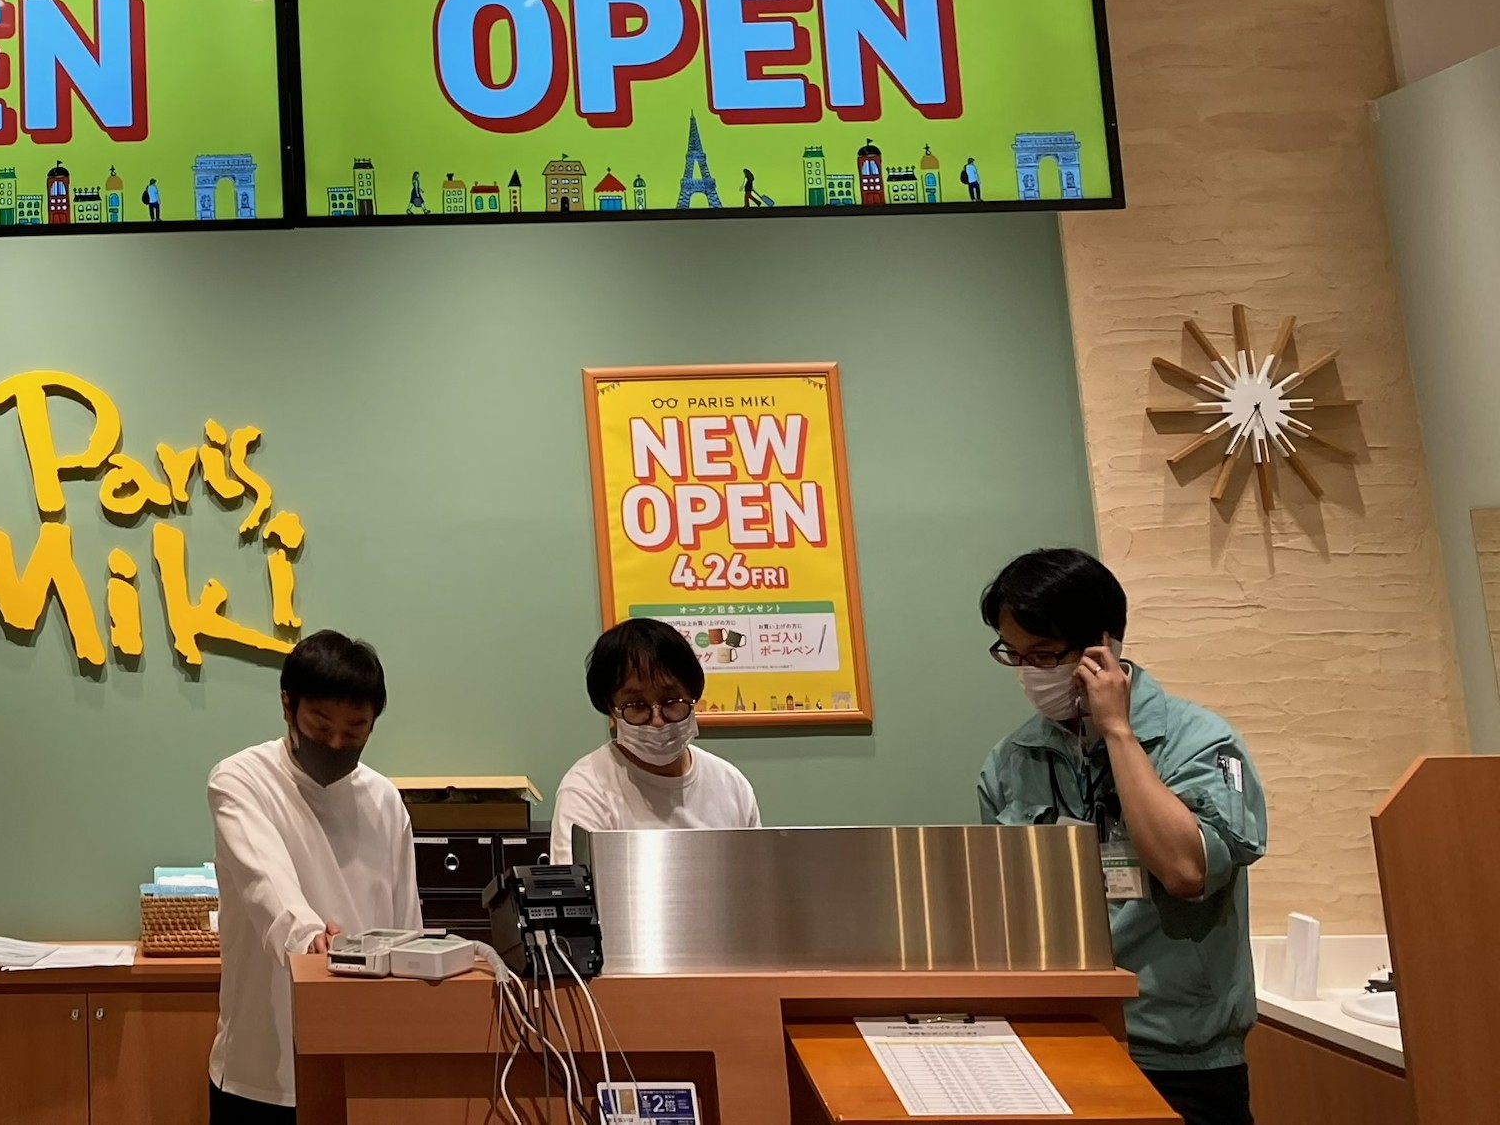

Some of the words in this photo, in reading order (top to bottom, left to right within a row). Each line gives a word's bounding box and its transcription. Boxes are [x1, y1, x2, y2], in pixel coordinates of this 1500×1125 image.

[687, 396, 735, 408] PARIS
[740, 395, 776, 407] MIKI
[629, 413, 808, 482] NEW
[621, 481, 827, 552] OPEN
[679, 604, 781, 614] オープン記念プレゼント
[759, 632, 803, 643] ロゴ入り
[760, 644, 815, 656] ボールペン
